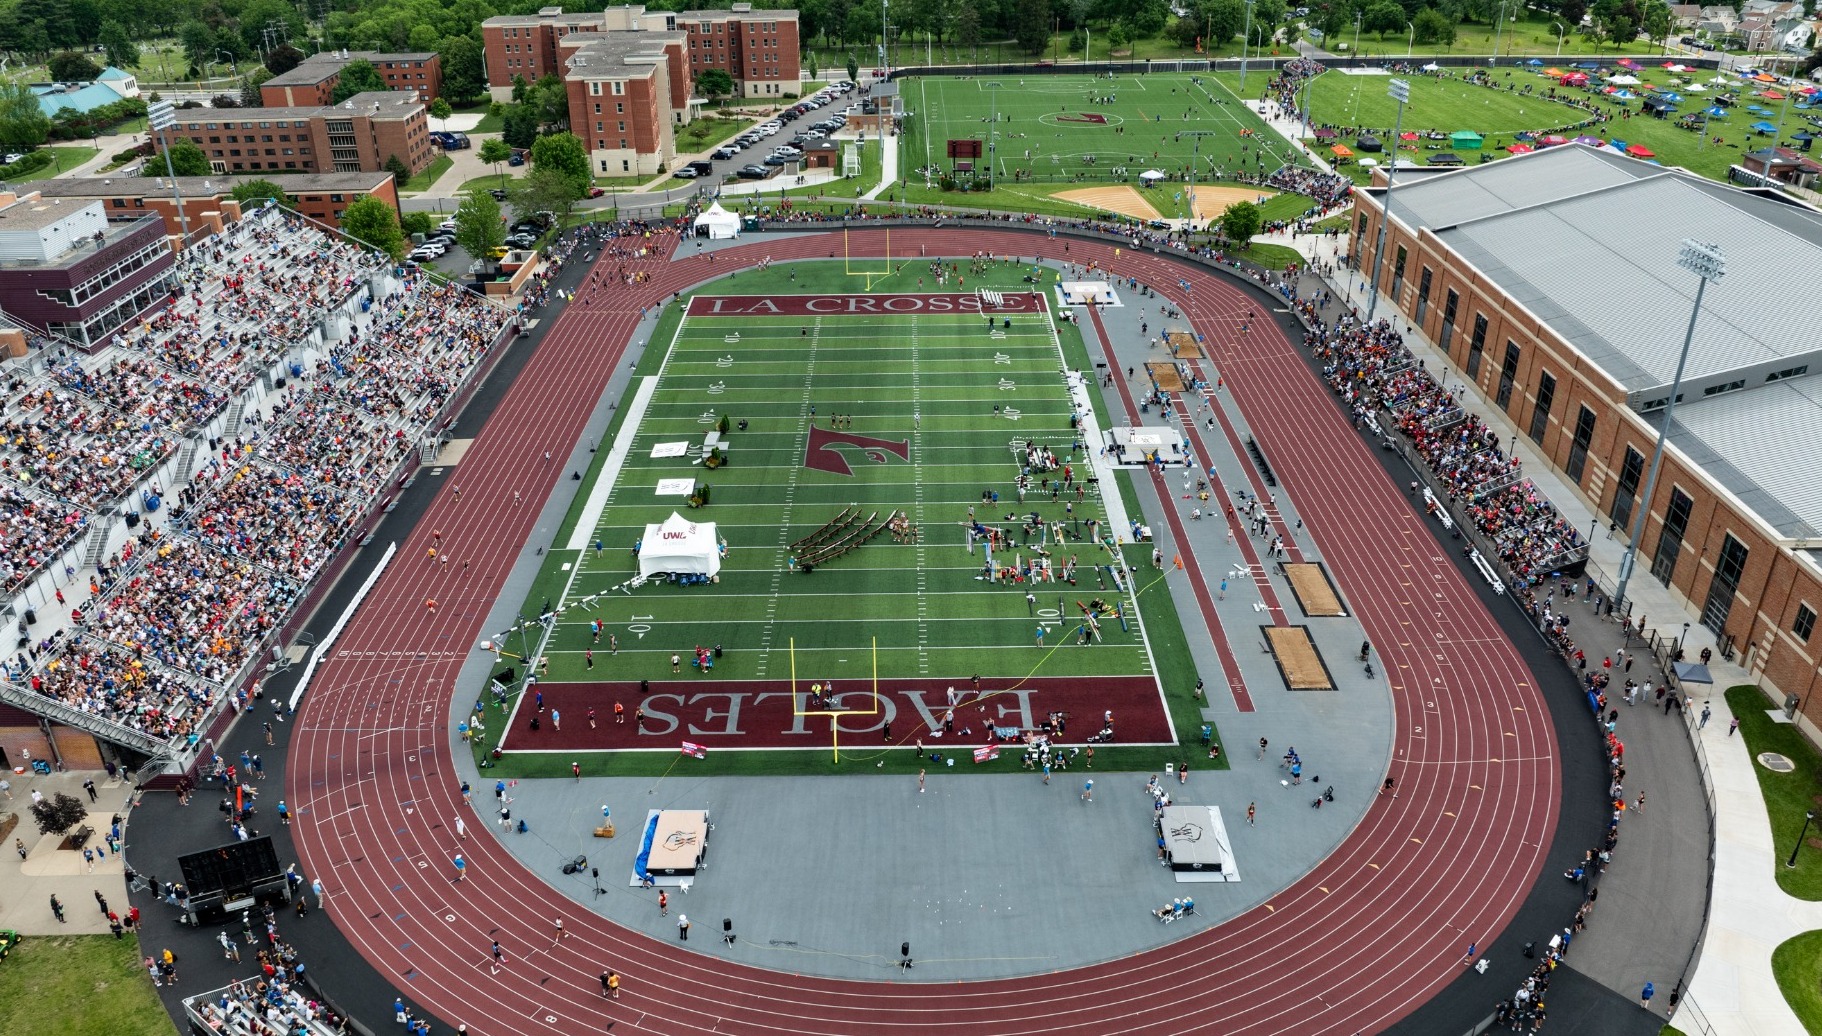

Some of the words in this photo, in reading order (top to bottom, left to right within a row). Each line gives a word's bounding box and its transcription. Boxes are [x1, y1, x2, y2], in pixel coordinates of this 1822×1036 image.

[707, 299, 784, 313] LA
[805, 297, 1025, 312] CROSSE
[716, 357, 733, 367] 20
[994, 354, 1011, 364] 20
[707, 384, 725, 394] 30
[998, 380, 1016, 390] 30
[697, 412, 716, 423] 40
[1037, 609, 1063, 626] 10
[628, 615, 654, 632] 10
[638, 690, 1043, 735] EAGLES
[418, 860, 428, 868] 5
[490, 966, 500, 975] 7
[546, 1015, 558, 1023] 8
